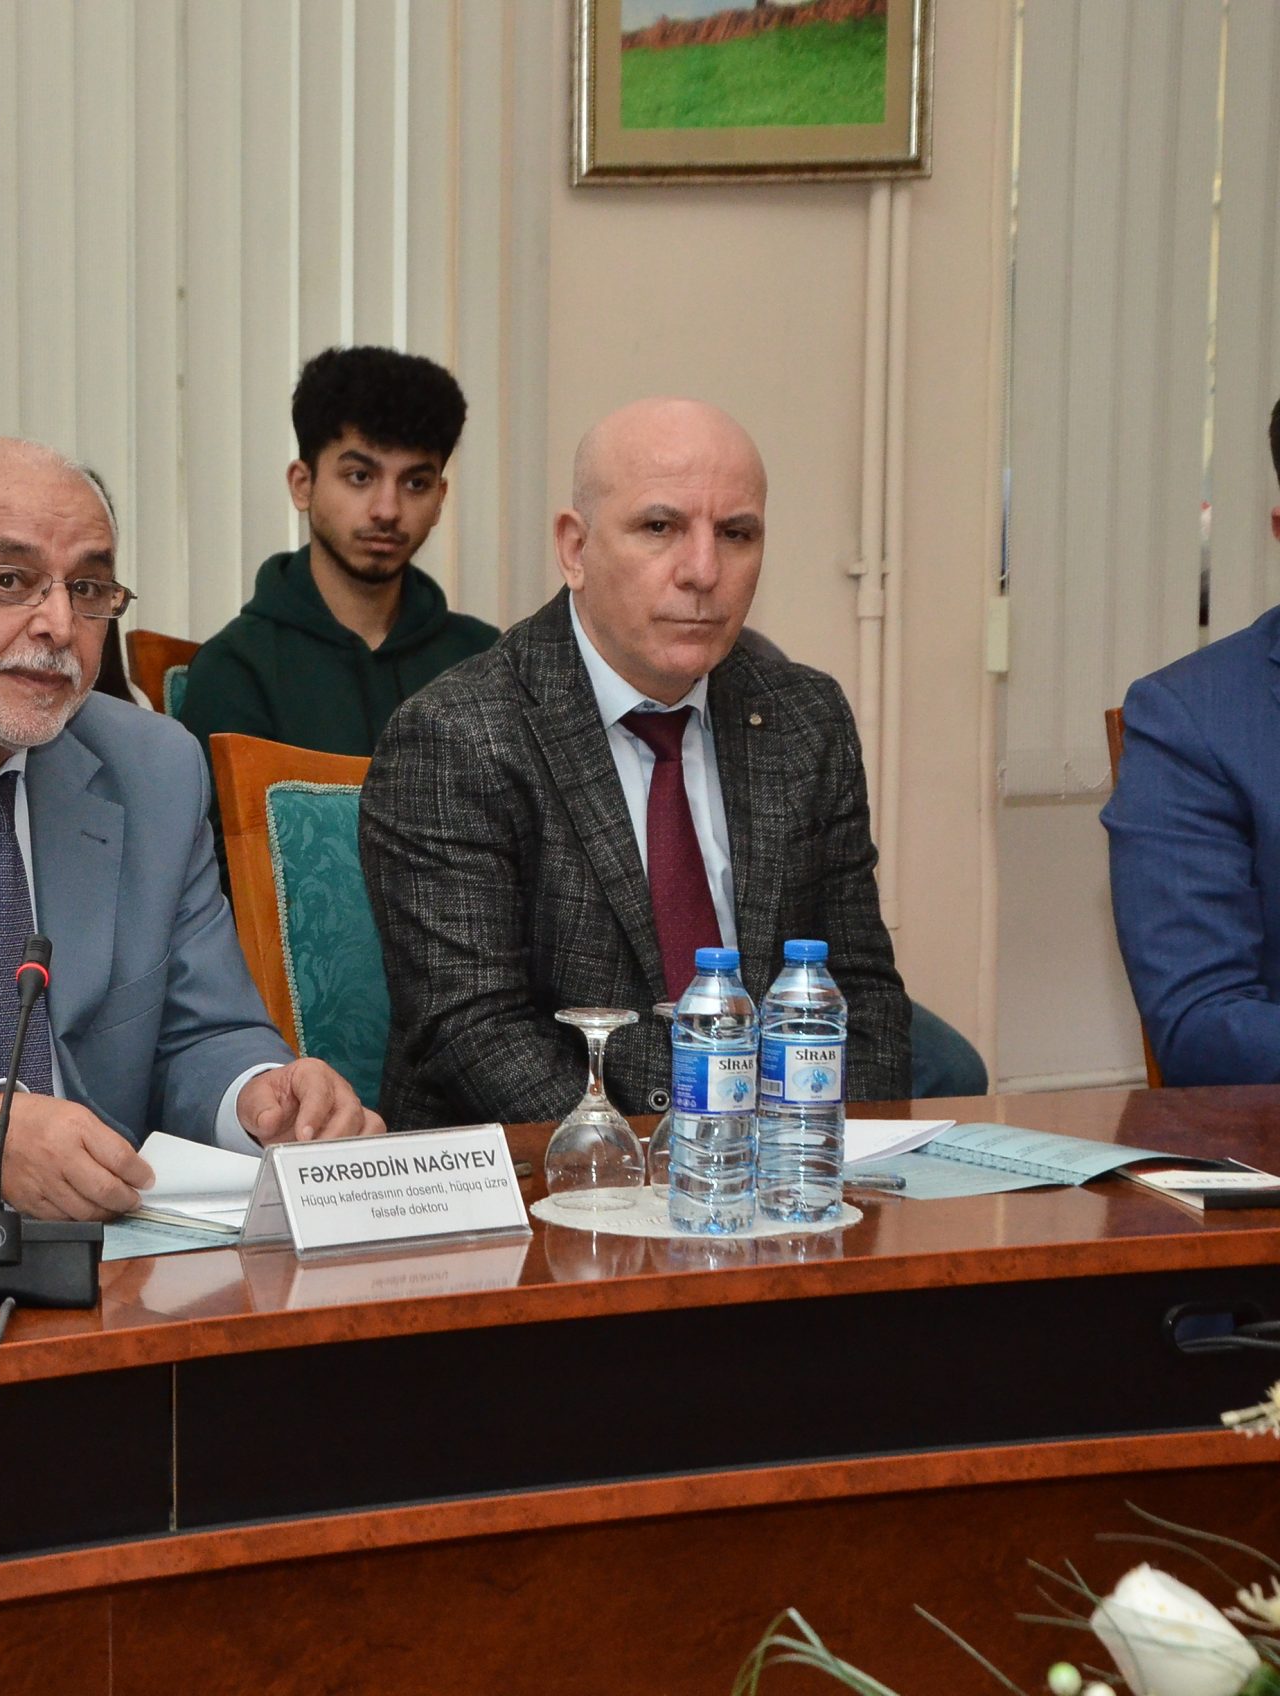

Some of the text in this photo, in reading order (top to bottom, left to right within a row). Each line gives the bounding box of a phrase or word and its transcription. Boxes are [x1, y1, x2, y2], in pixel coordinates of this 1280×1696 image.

[795, 1048, 837, 1061] SİRAB
[719, 1057, 754, 1071] SİRAB
[298, 1149, 495, 1184] FƏXRƏDDİN NAĞIYEV
[300, 1177, 508, 1208] Hüquq kafedrasının dosenti, hüquq üzrə
[370, 1202, 449, 1219] fəlsəfə doktoru
